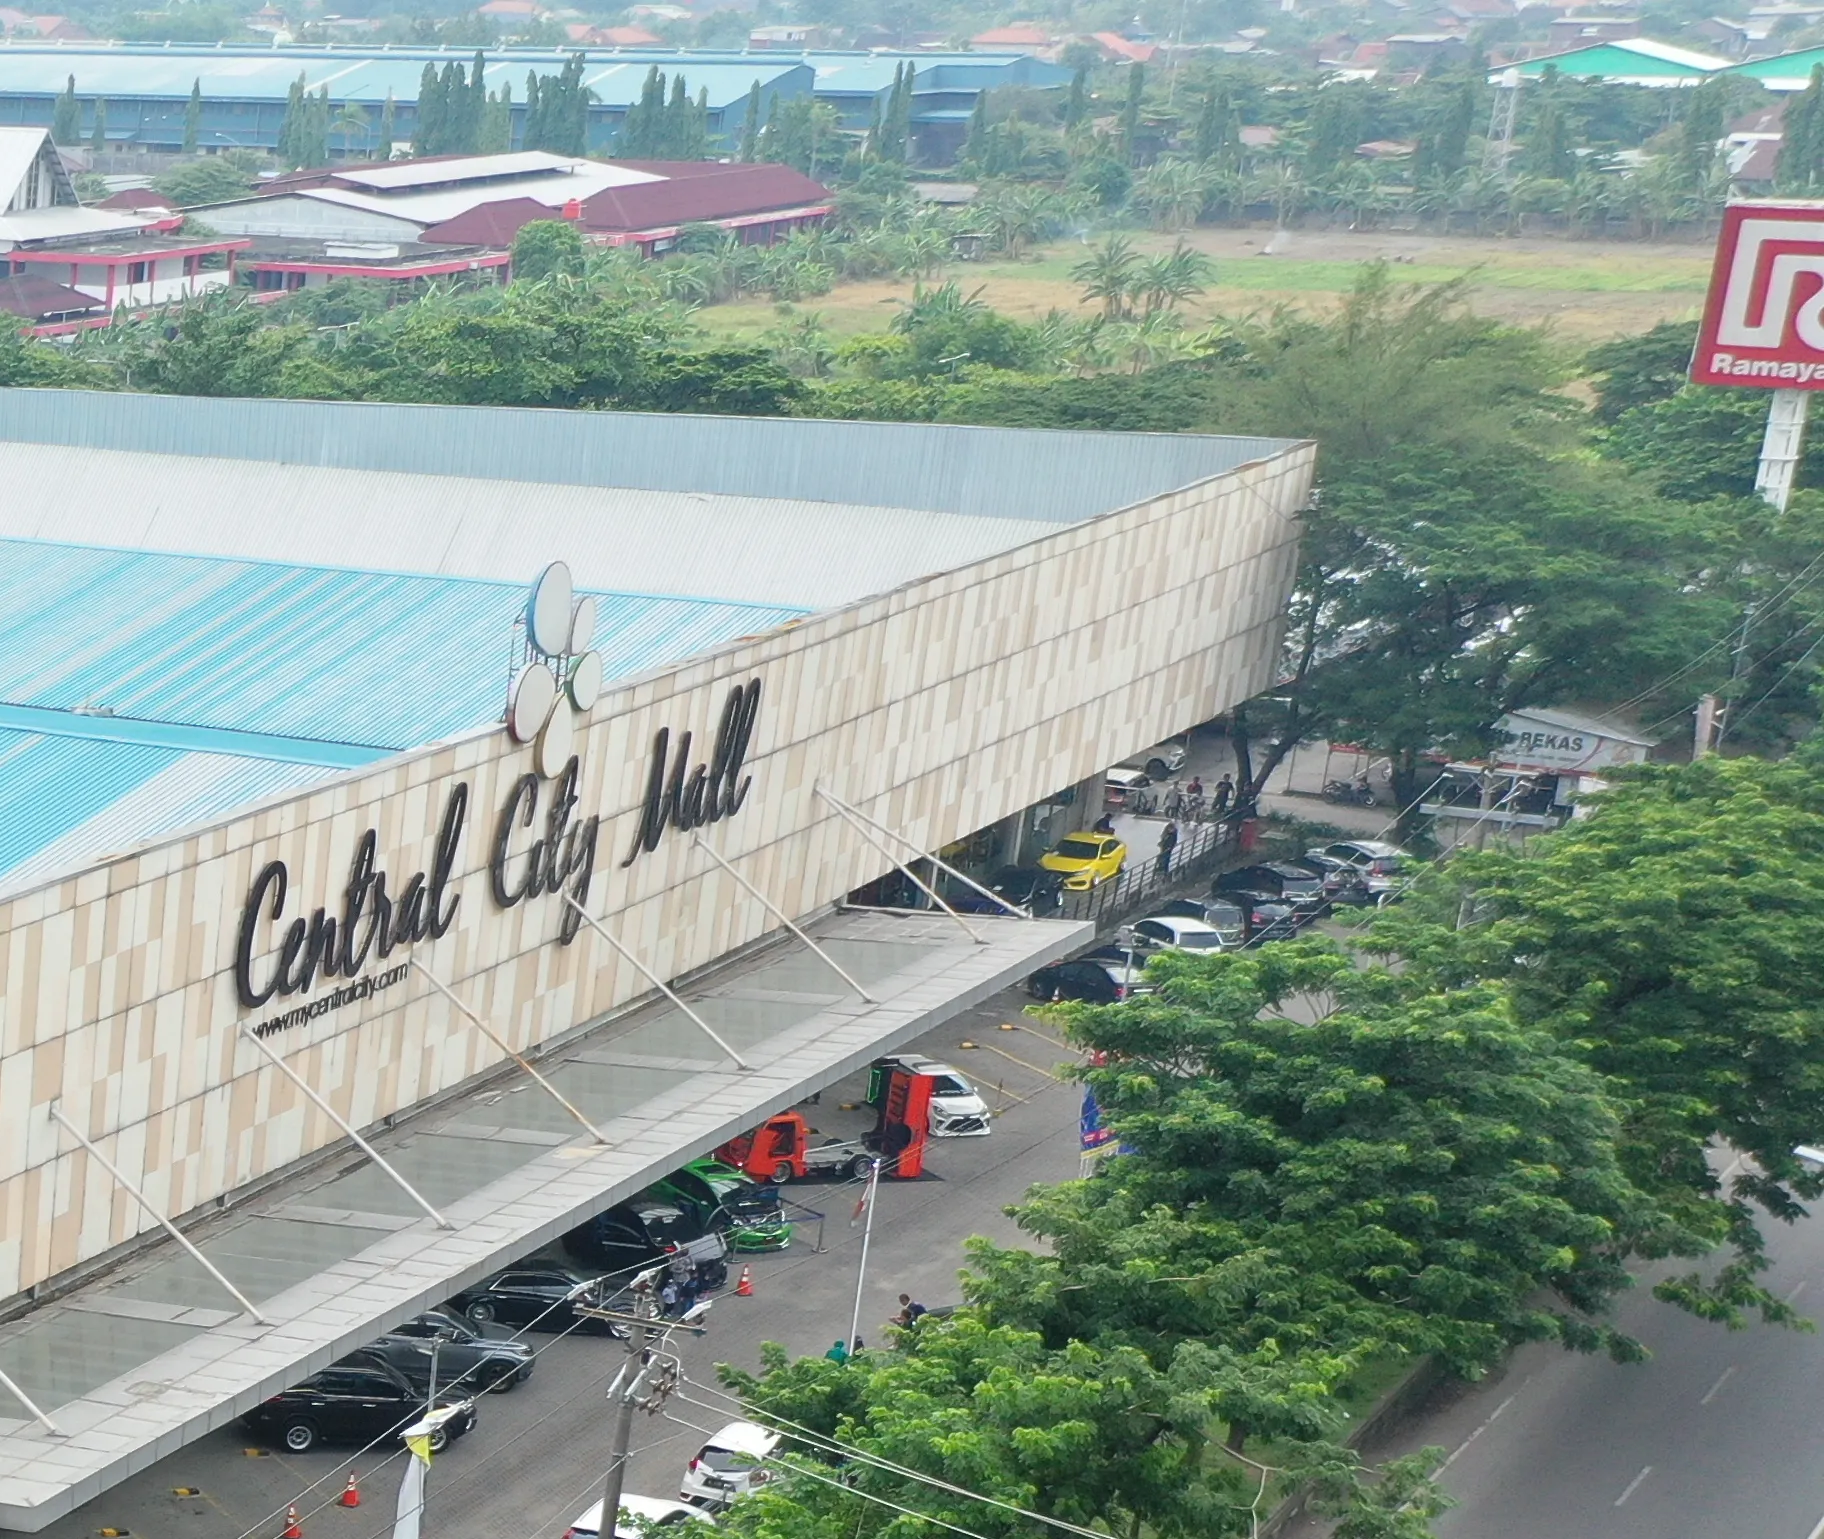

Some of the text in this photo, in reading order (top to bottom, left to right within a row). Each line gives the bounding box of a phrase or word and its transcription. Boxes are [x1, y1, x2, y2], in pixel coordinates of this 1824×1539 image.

[235, 676, 761, 1009] Central City Mall
